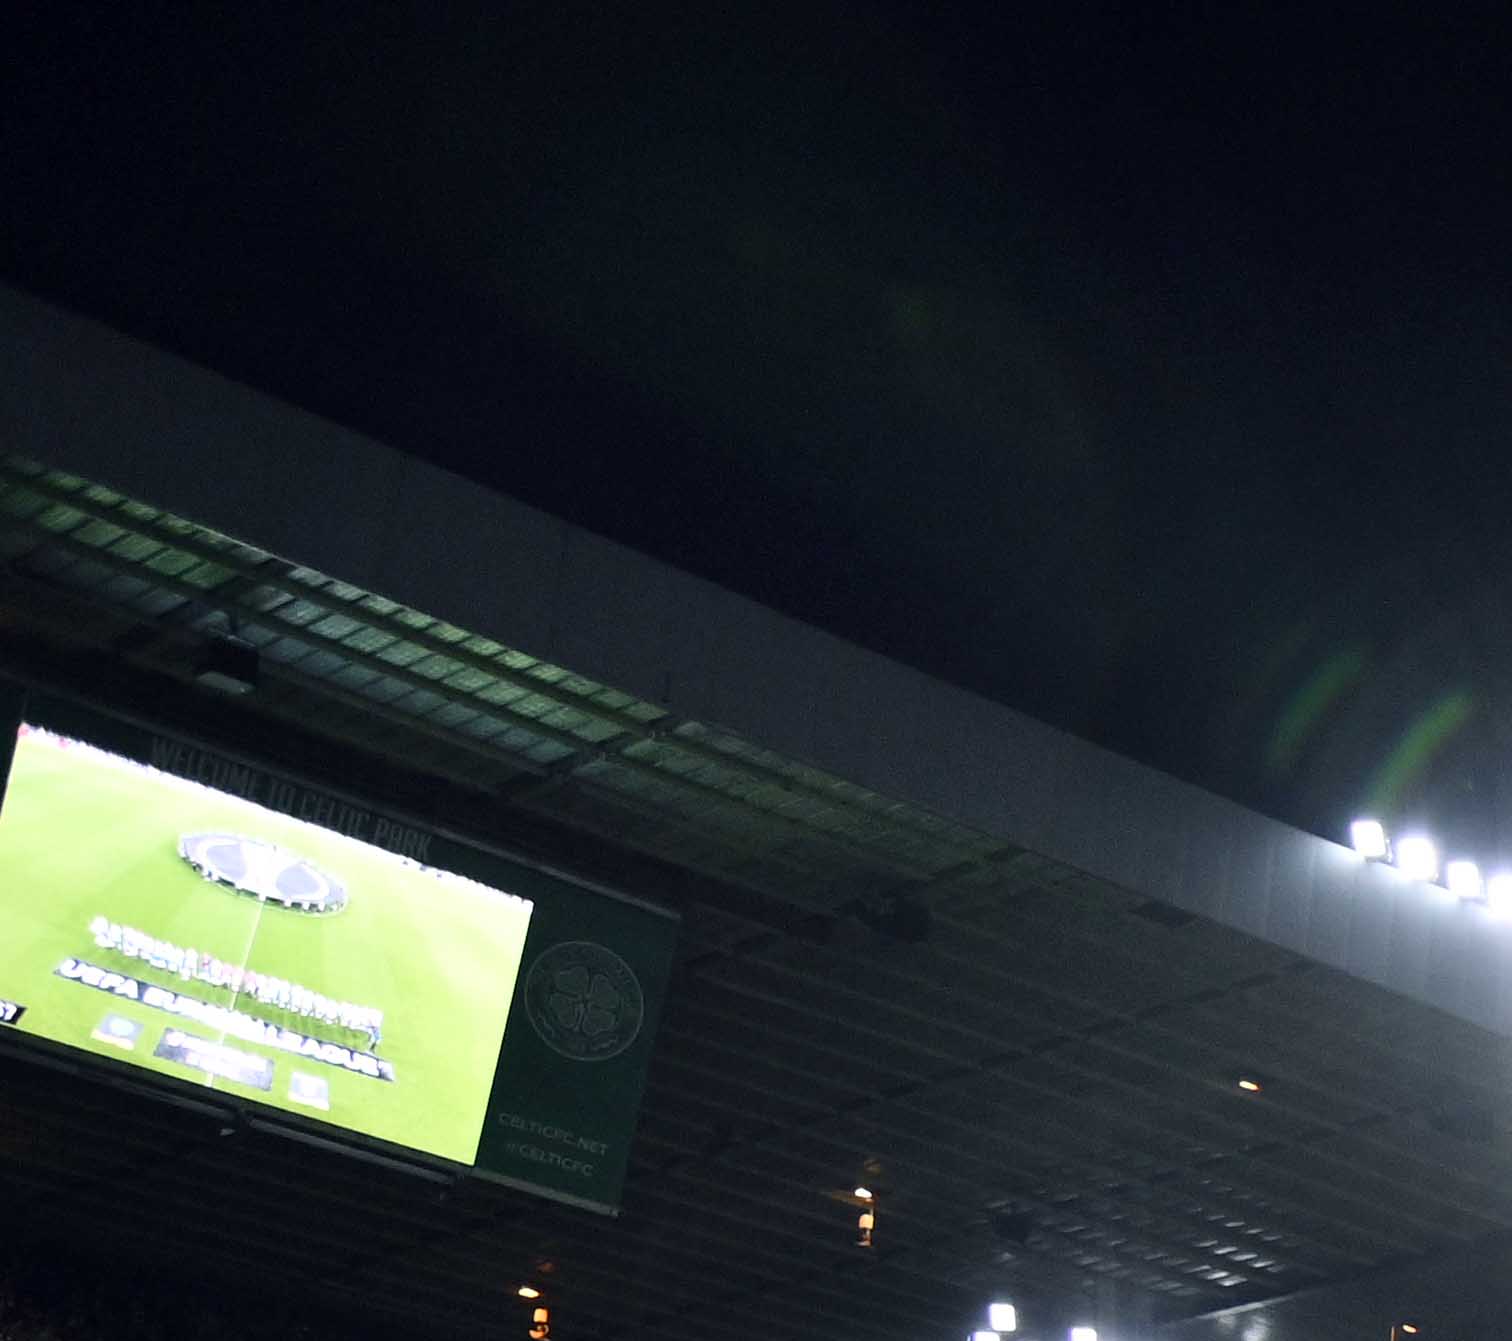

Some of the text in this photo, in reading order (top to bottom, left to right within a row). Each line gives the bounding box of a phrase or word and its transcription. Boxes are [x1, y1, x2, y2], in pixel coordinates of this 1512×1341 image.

[152, 737, 433, 860] WELCOME TO CELTIC PARK
